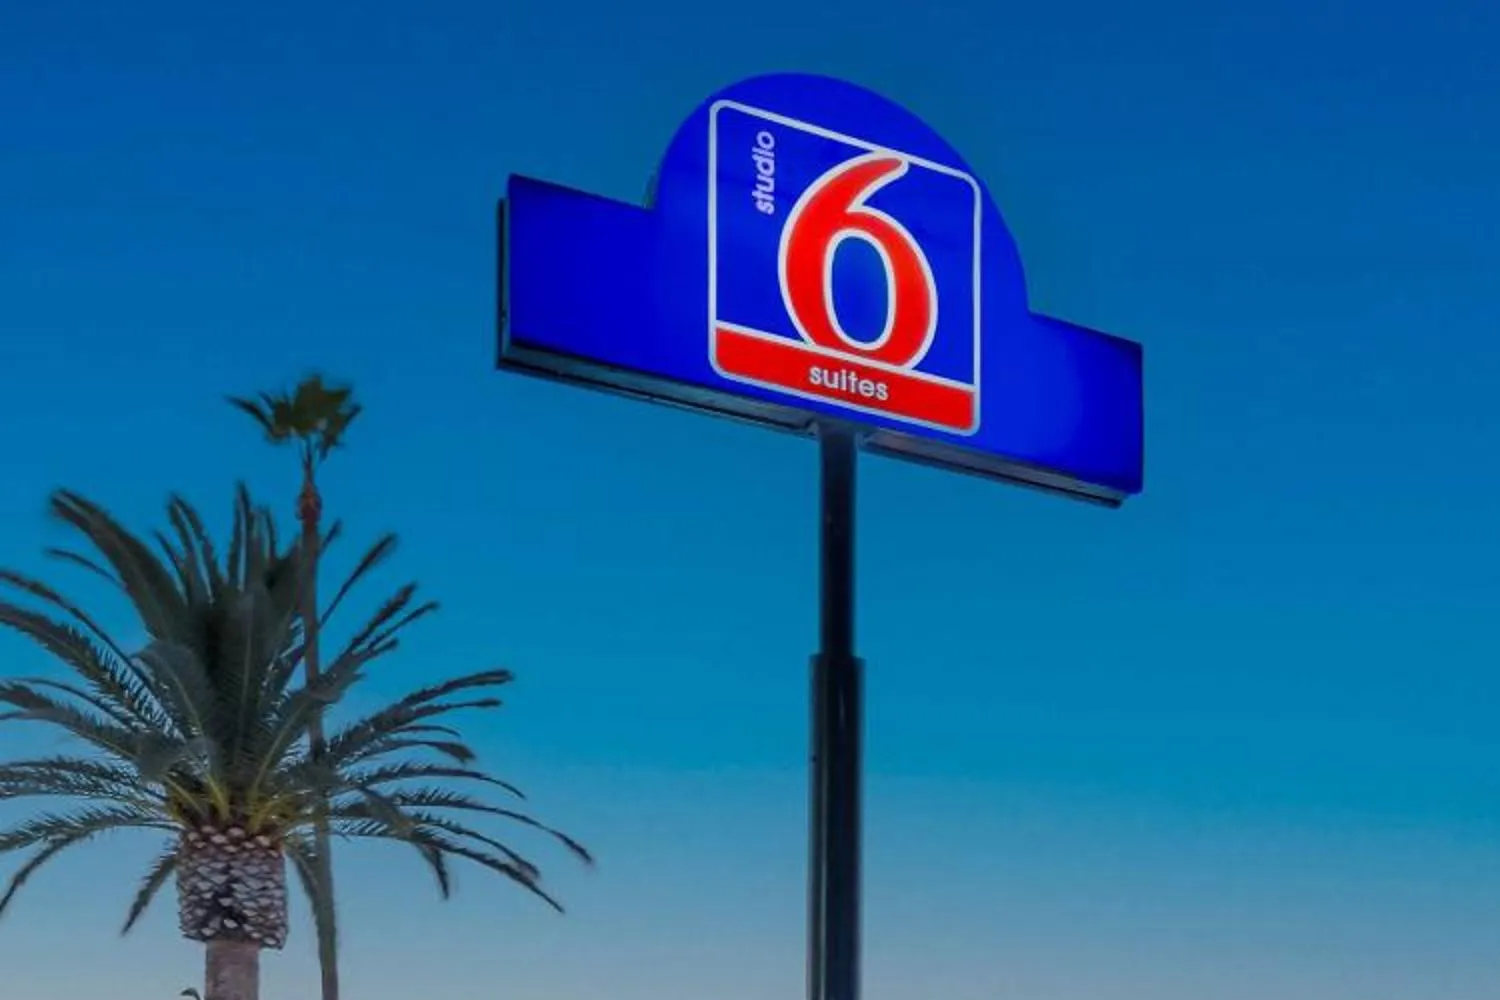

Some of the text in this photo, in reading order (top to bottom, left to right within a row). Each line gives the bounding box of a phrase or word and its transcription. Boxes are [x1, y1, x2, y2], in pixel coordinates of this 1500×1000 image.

[751, 131, 775, 215] studio
[778, 150, 938, 370] 6
[808, 364, 889, 400] suites
